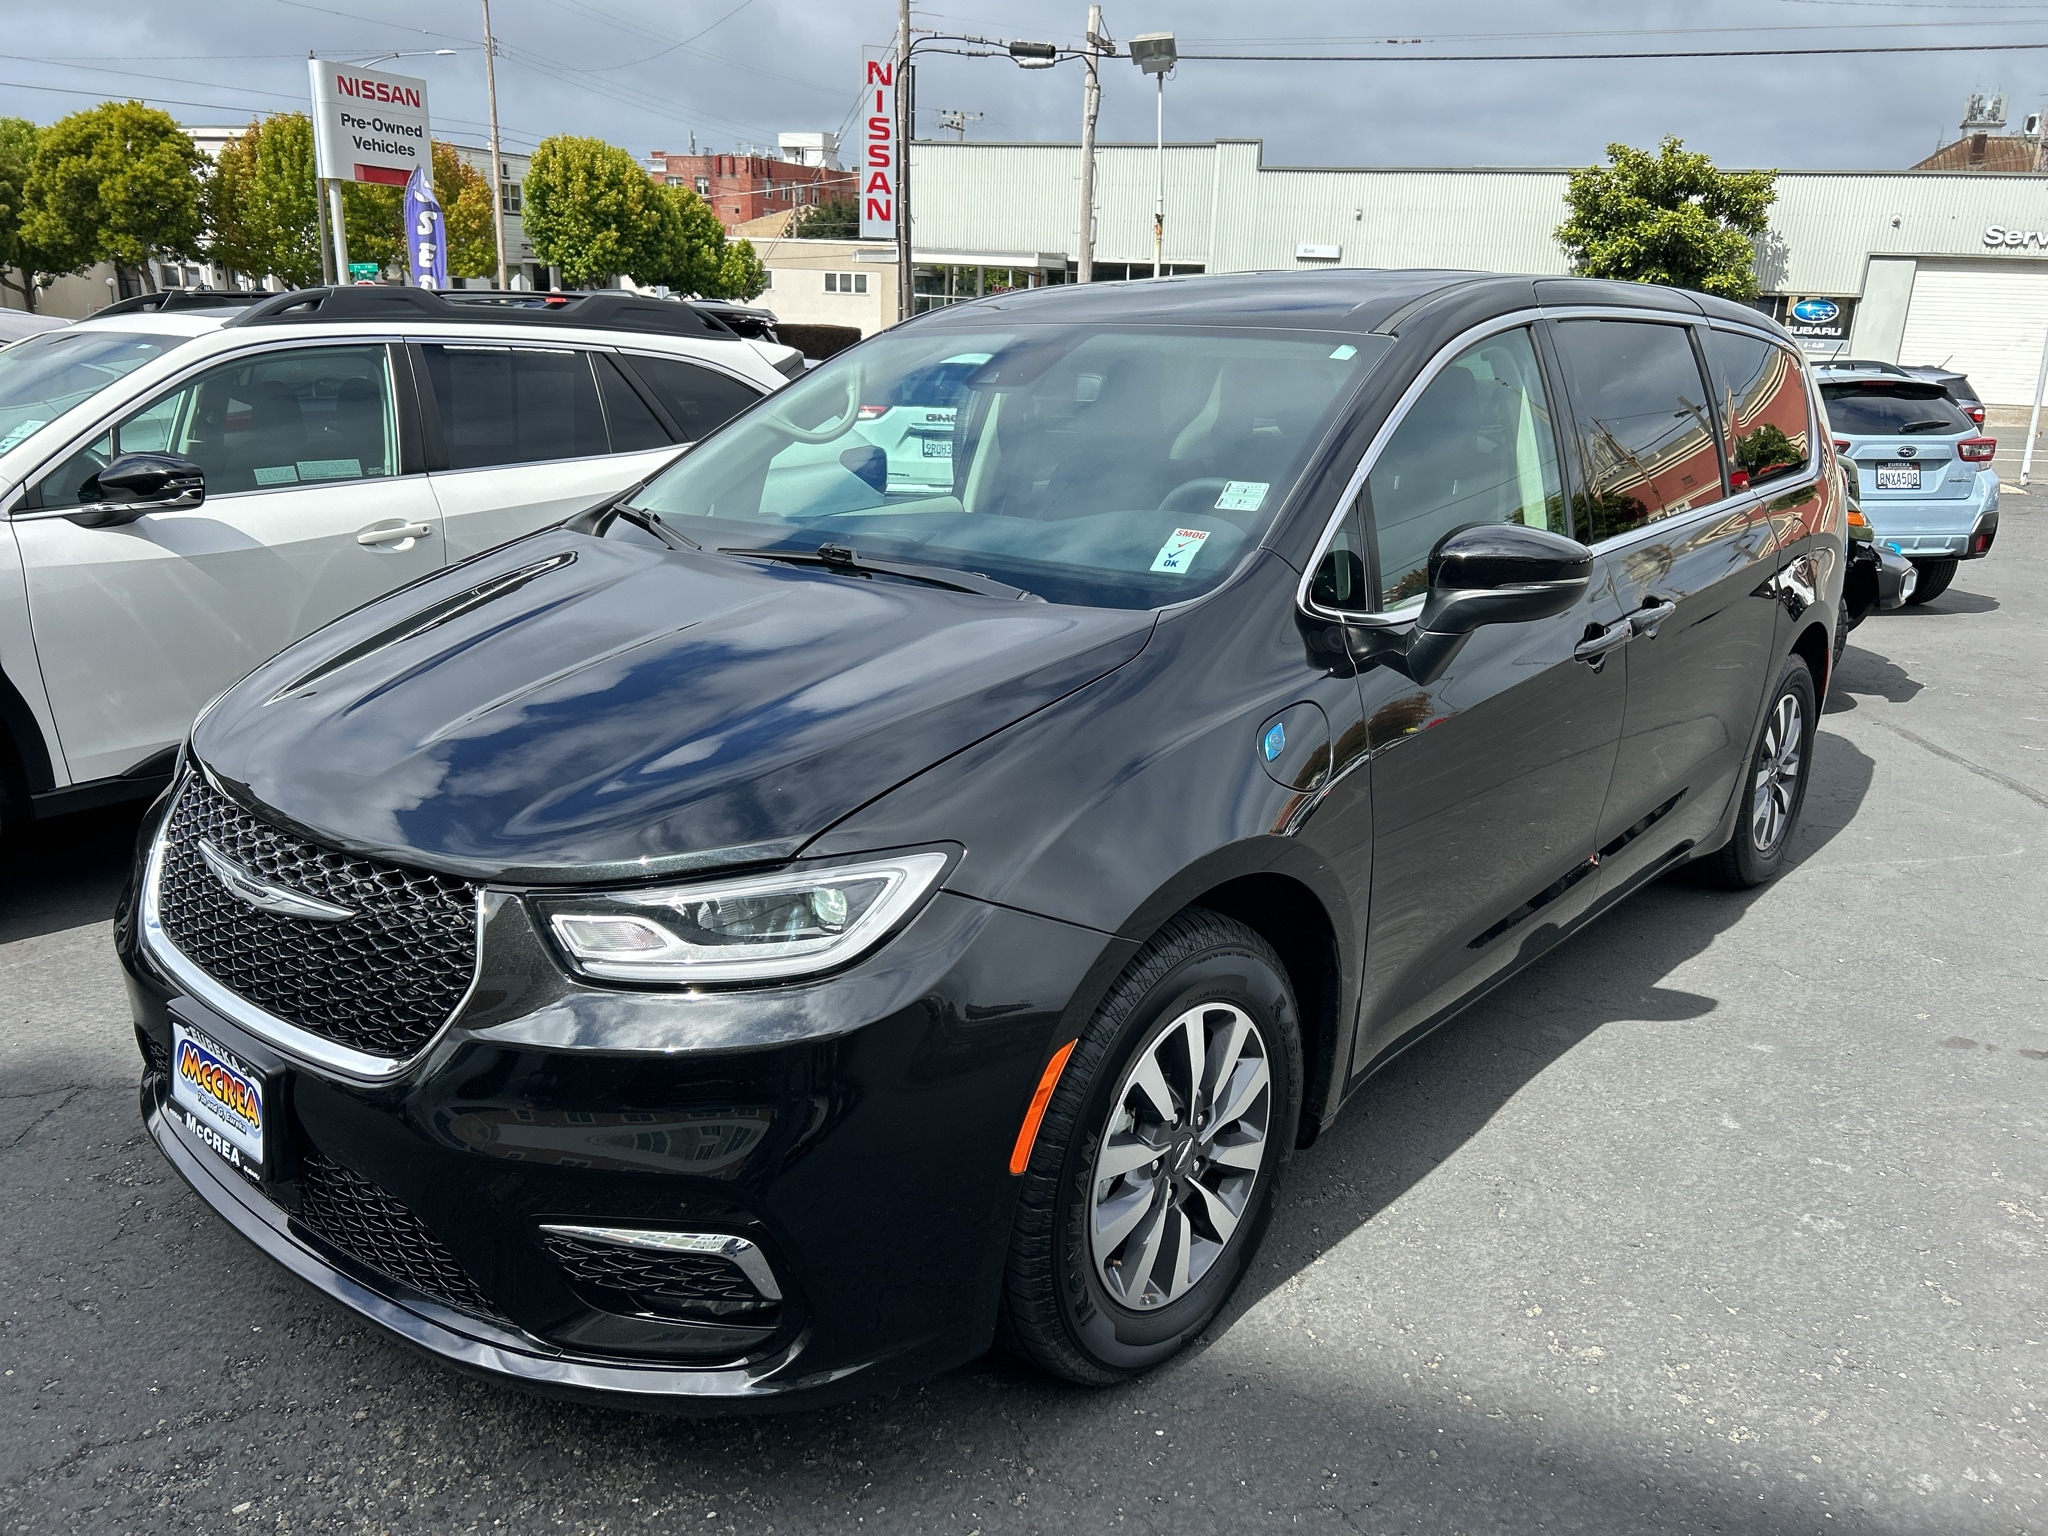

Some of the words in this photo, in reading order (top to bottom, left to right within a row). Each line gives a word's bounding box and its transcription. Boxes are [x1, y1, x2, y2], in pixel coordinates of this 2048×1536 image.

[337, 75, 420, 108] NISSAN
[340, 112, 423, 138] Pre-Owned
[352, 135, 416, 157] Vehicles
[866, 61, 892, 222] NISSAN
[1783, 326, 1842, 336] SUBARU
[1176, 530, 1207, 540] SMOG
[1163, 560, 1179, 568] OK
[189, 1026, 242, 1073] EUREKA
[226, 1111, 247, 1135] Eureka
[186, 1112, 241, 1167] McCREA
[1067, 1130, 1098, 1327] IRONMAN
